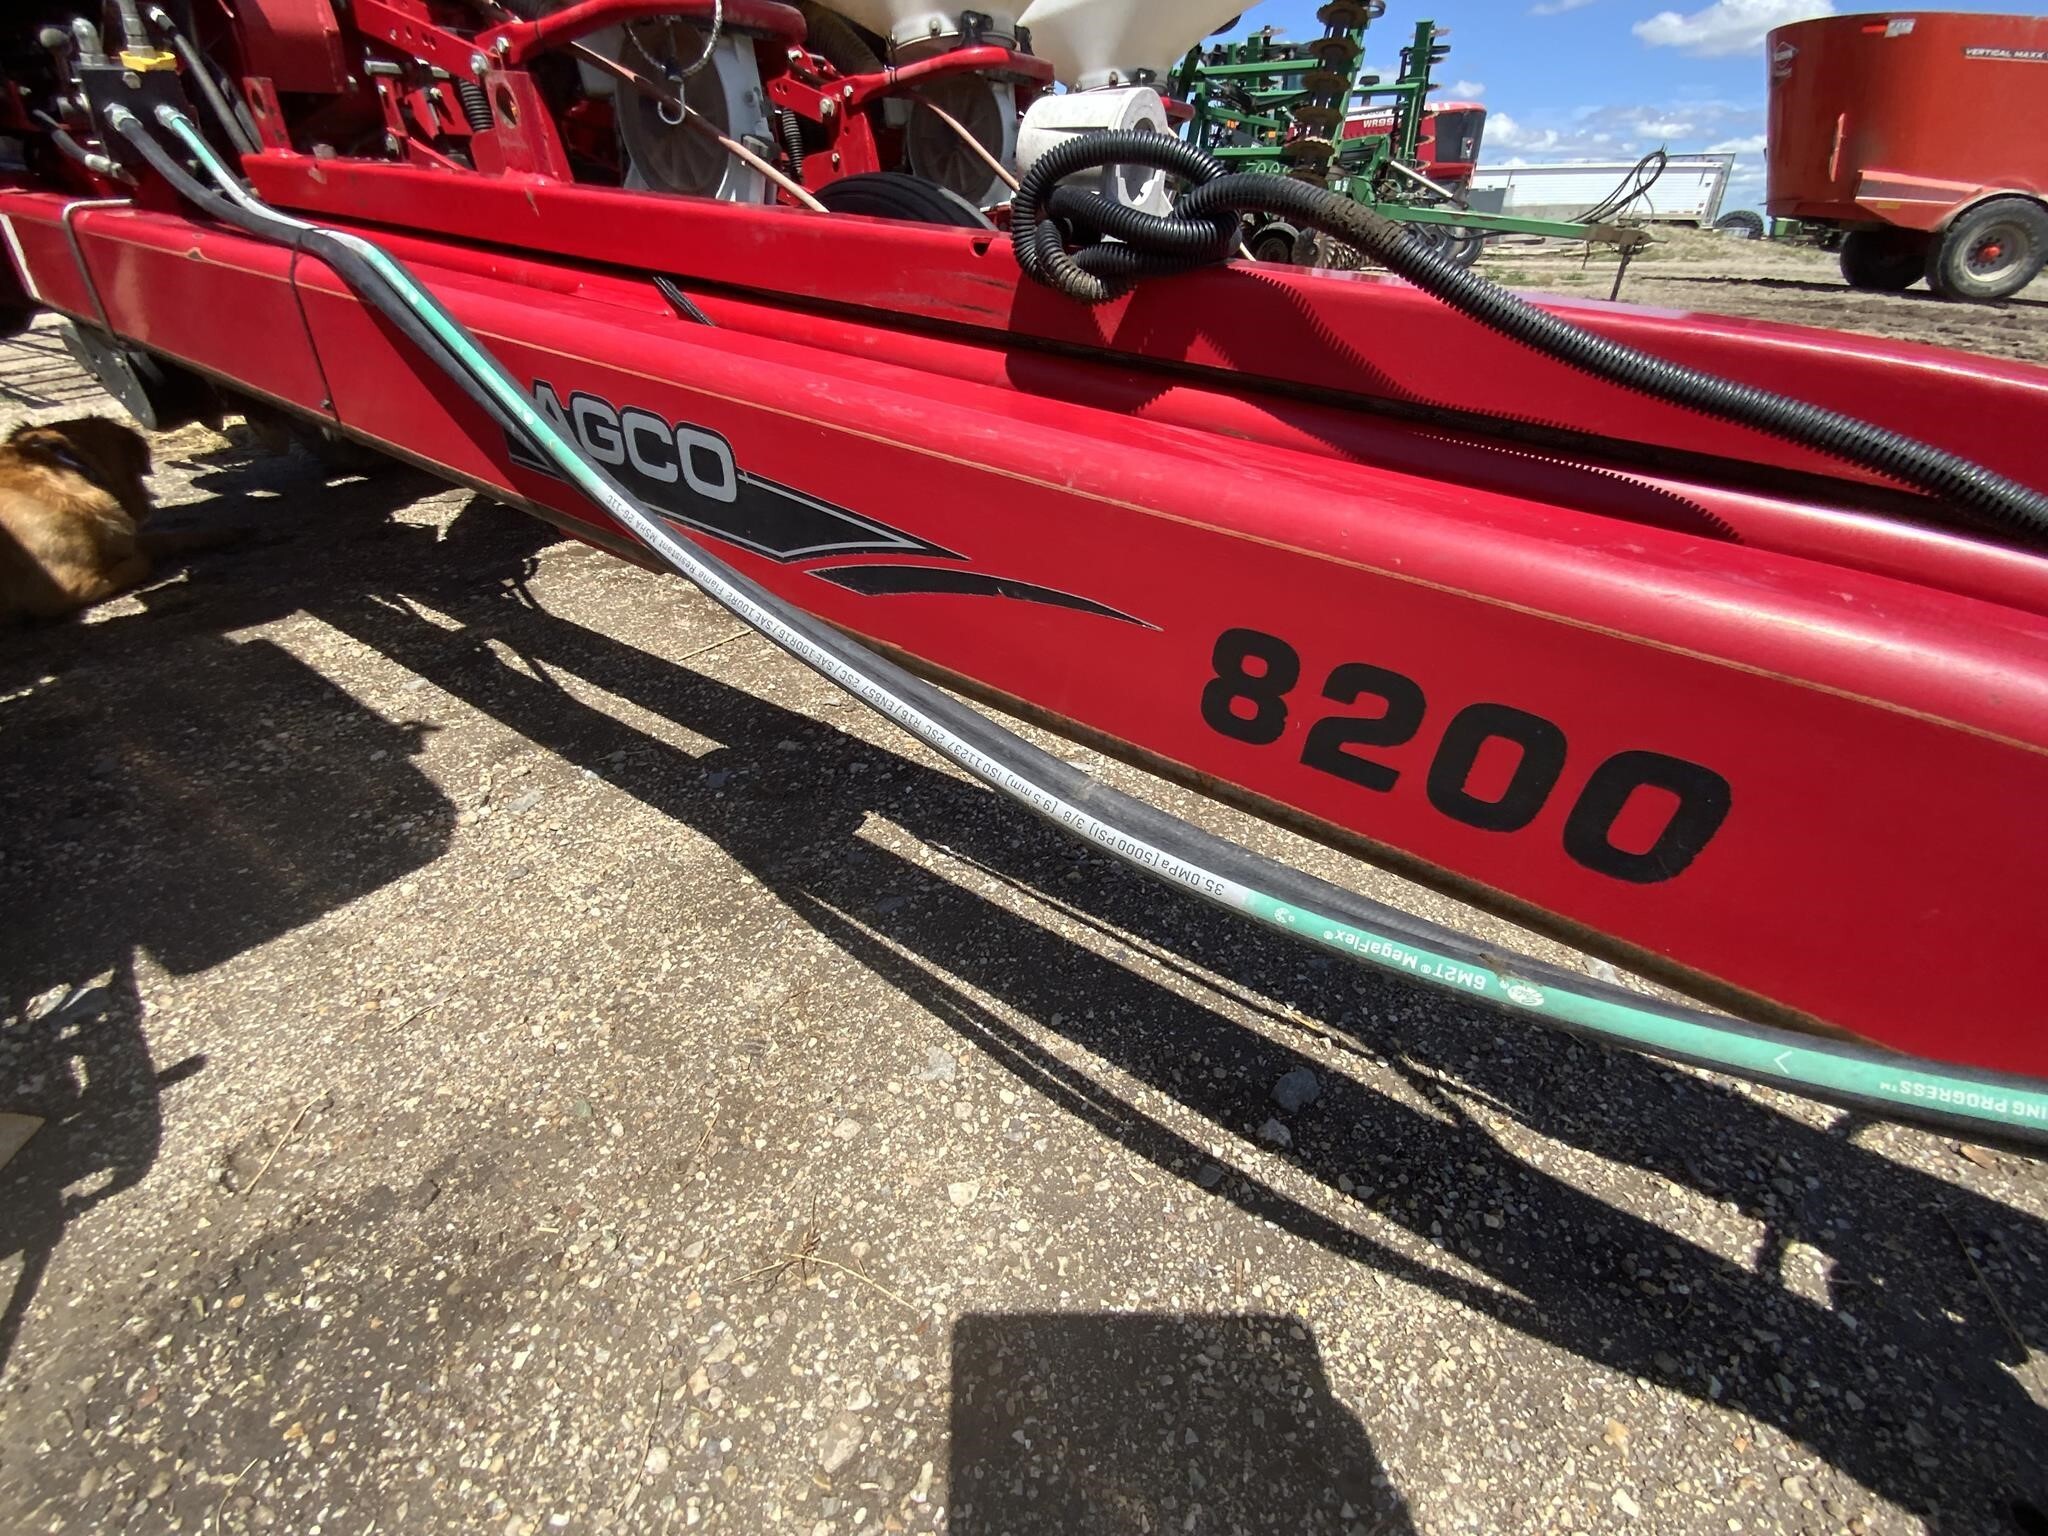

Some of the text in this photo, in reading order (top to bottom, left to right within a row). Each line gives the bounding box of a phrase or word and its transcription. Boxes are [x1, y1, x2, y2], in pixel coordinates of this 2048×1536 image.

[2013, 50, 2045, 59] MAXX
[634, 519, 657, 544] MSHA
[658, 539, 696, 574] Resistant
[697, 571, 725, 595] Flame
[947, 741, 983, 768] 11237
[1201, 627, 1732, 885] 8200
[983, 762, 1002, 780] ISO
[1161, 859, 1225, 896] 35.0MPa
